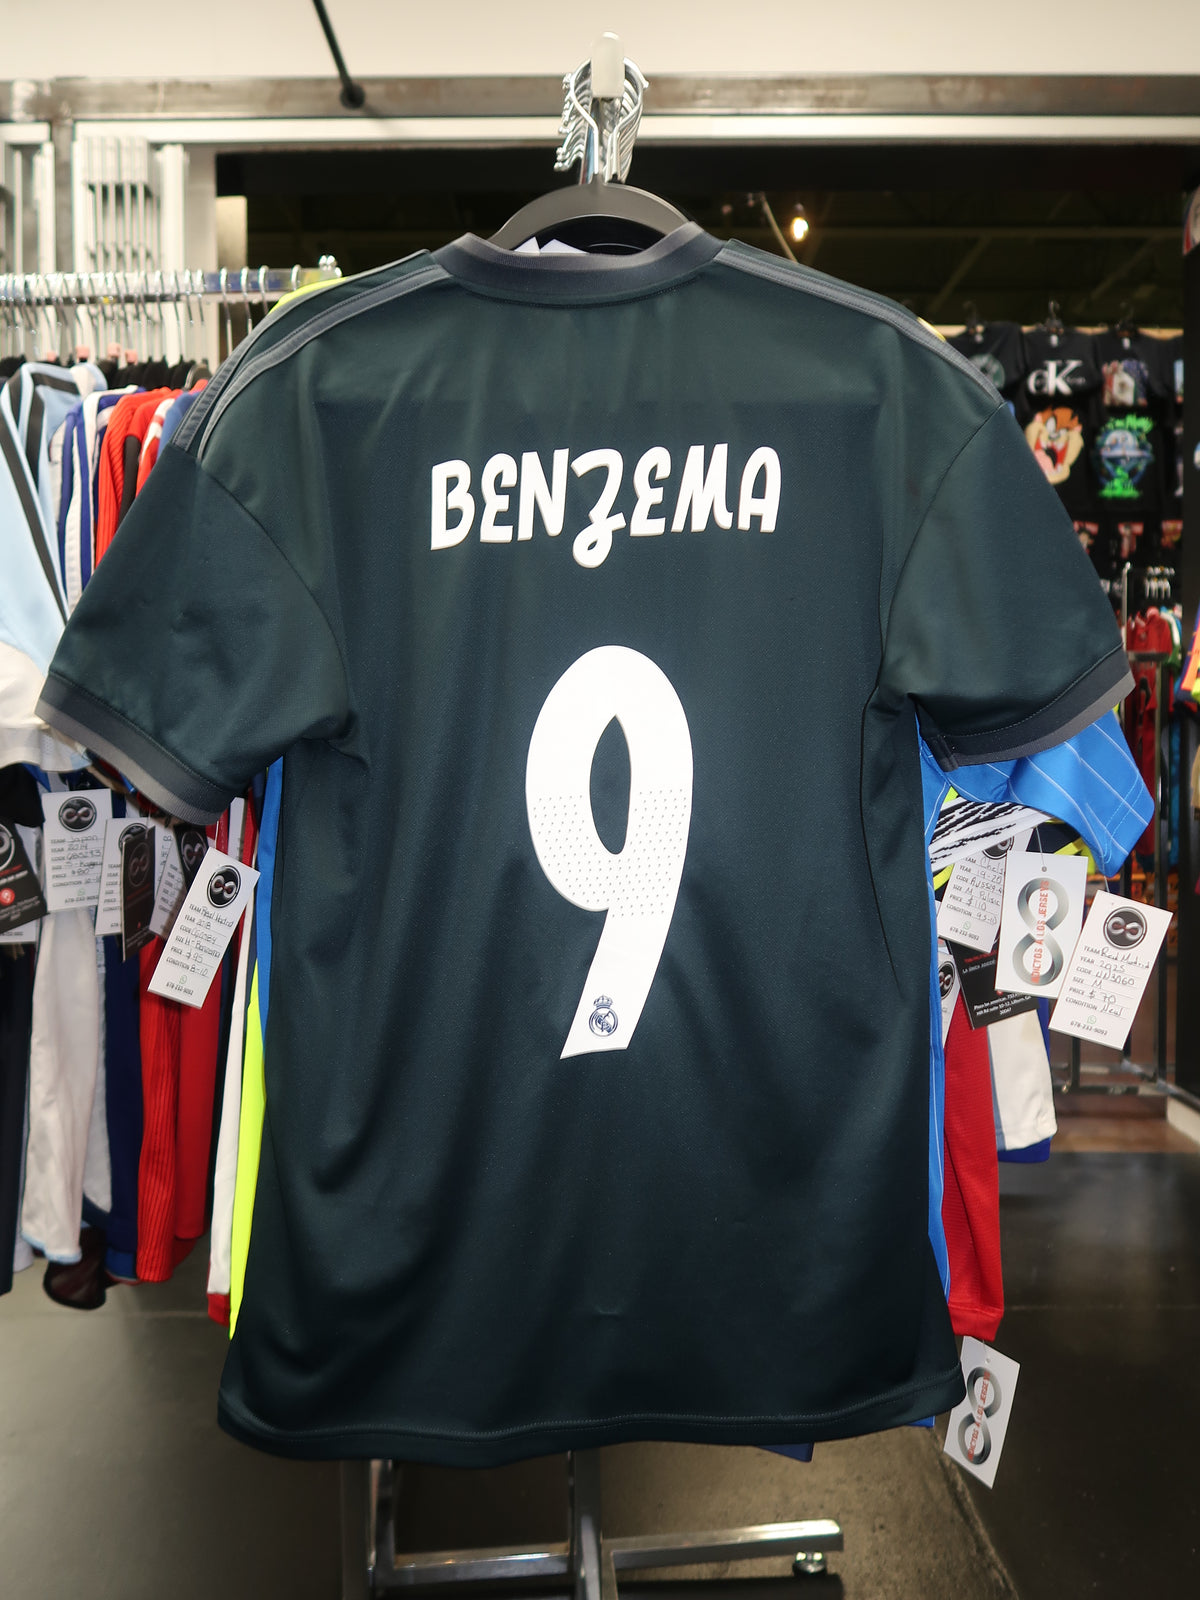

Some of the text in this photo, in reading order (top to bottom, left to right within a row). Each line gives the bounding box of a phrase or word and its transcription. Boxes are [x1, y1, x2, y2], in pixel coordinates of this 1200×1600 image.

[431, 443, 782, 569] BENZEMA
[525, 645, 694, 1060] 9
[1038, 880, 1050, 918] JERSEYS
[946, 903, 973, 917] CONDITION
[1036, 920, 1046, 937] LOS
[1084, 945, 1101, 955] TEAM
[1081, 956, 1095, 964] YEAR
[1076, 966, 1092, 975] CODE
[1069, 986, 1085, 996] PRICE
[1065, 996, 1098, 1011] CONDITION
